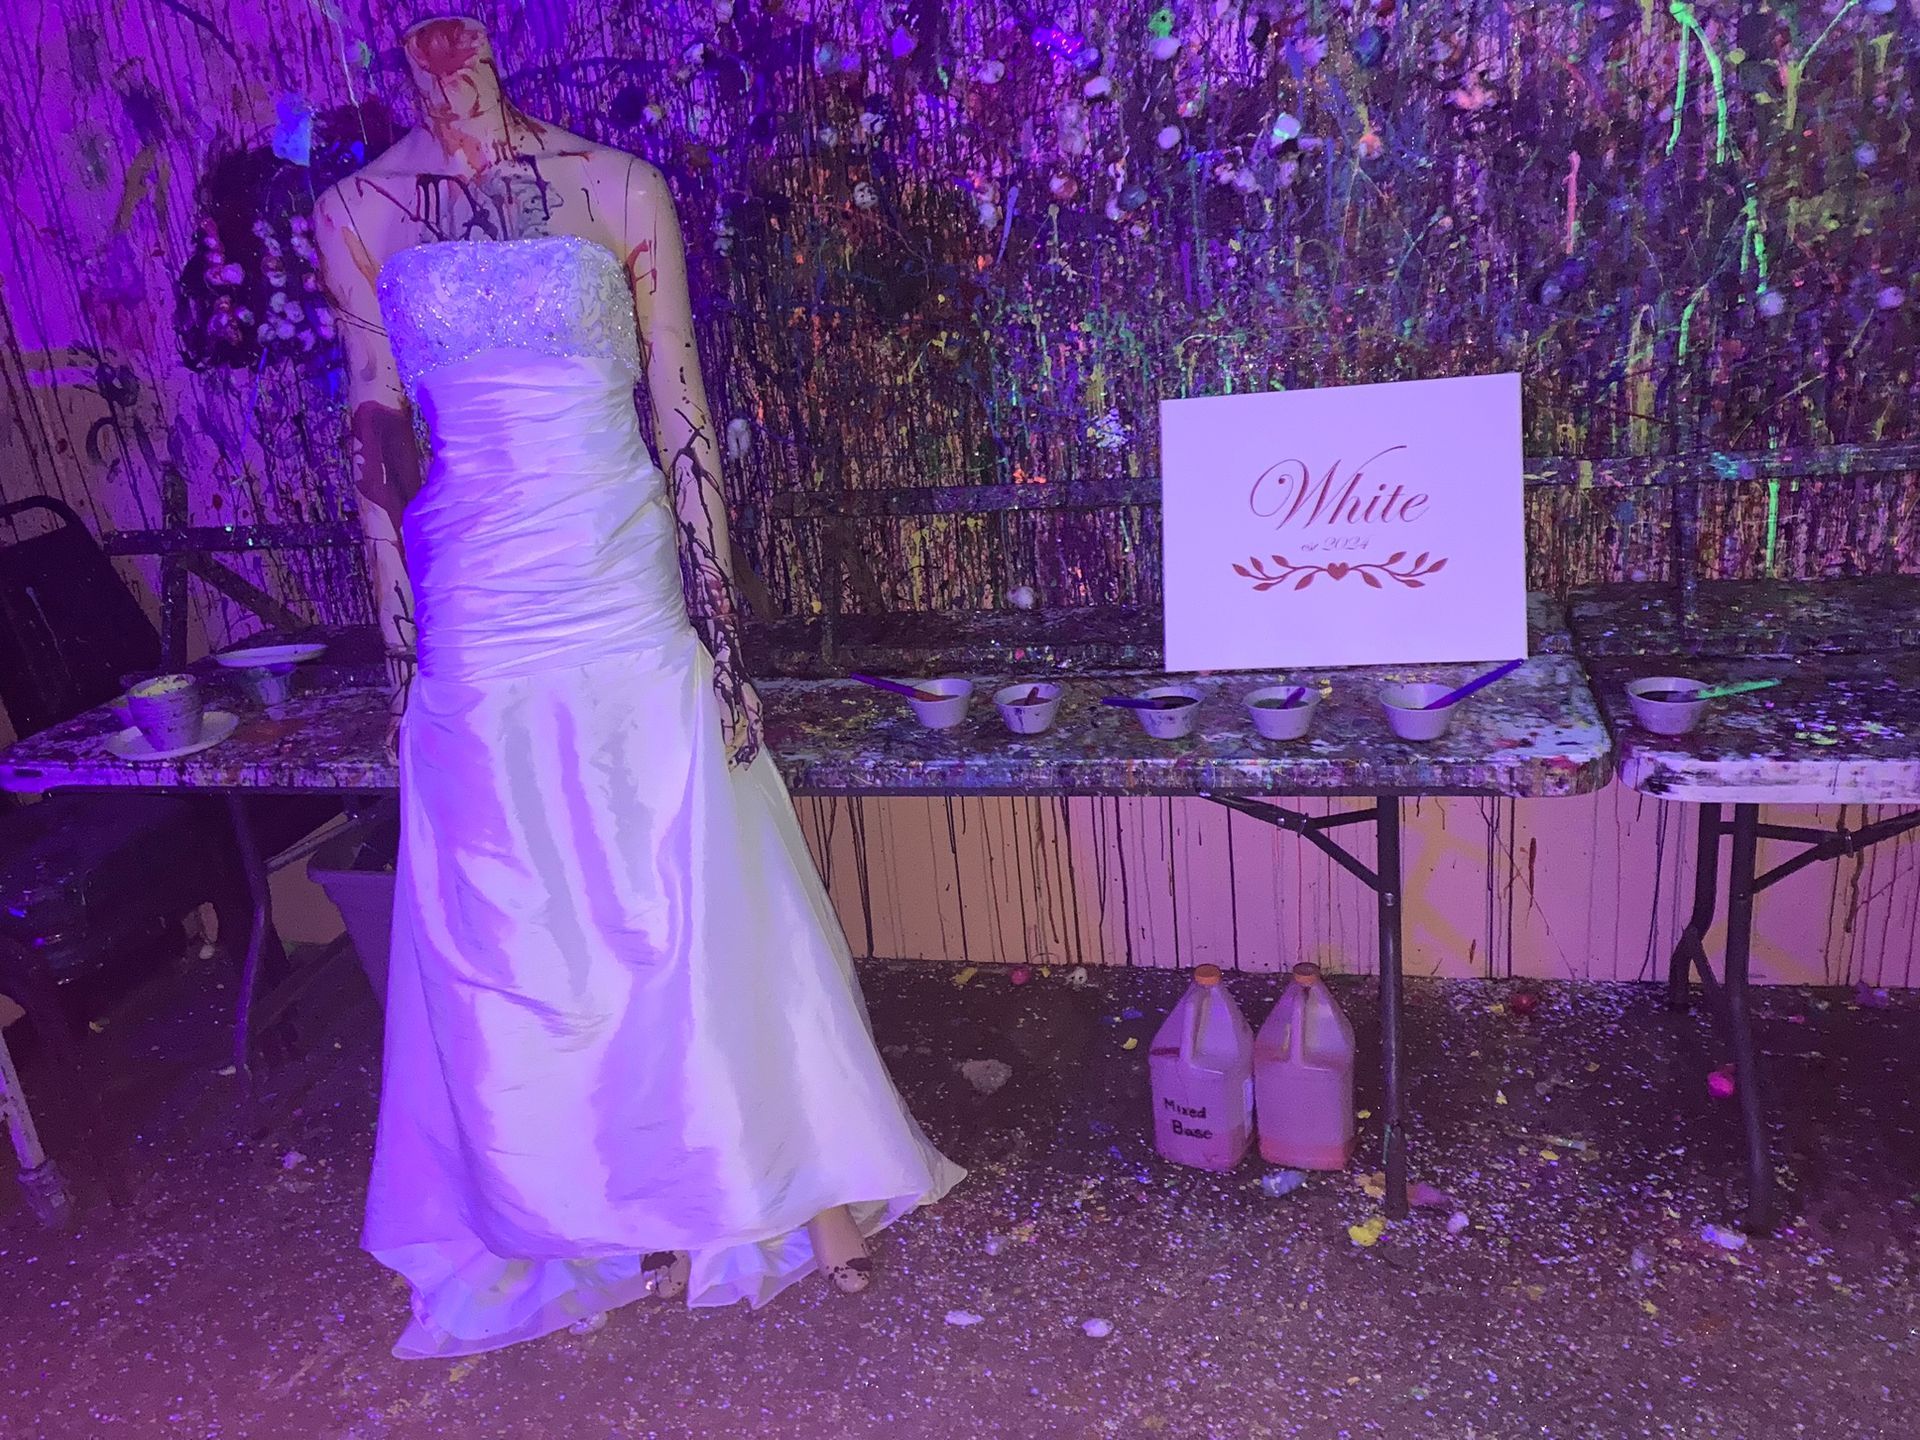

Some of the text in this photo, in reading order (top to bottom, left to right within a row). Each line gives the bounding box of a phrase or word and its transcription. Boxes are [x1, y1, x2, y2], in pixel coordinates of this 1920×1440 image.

[1250, 445, 1430, 531] White
[1321, 535, 1370, 551] 2024
[1163, 1098, 1207, 1119] Mixed
[1171, 1119, 1213, 1139] Base
